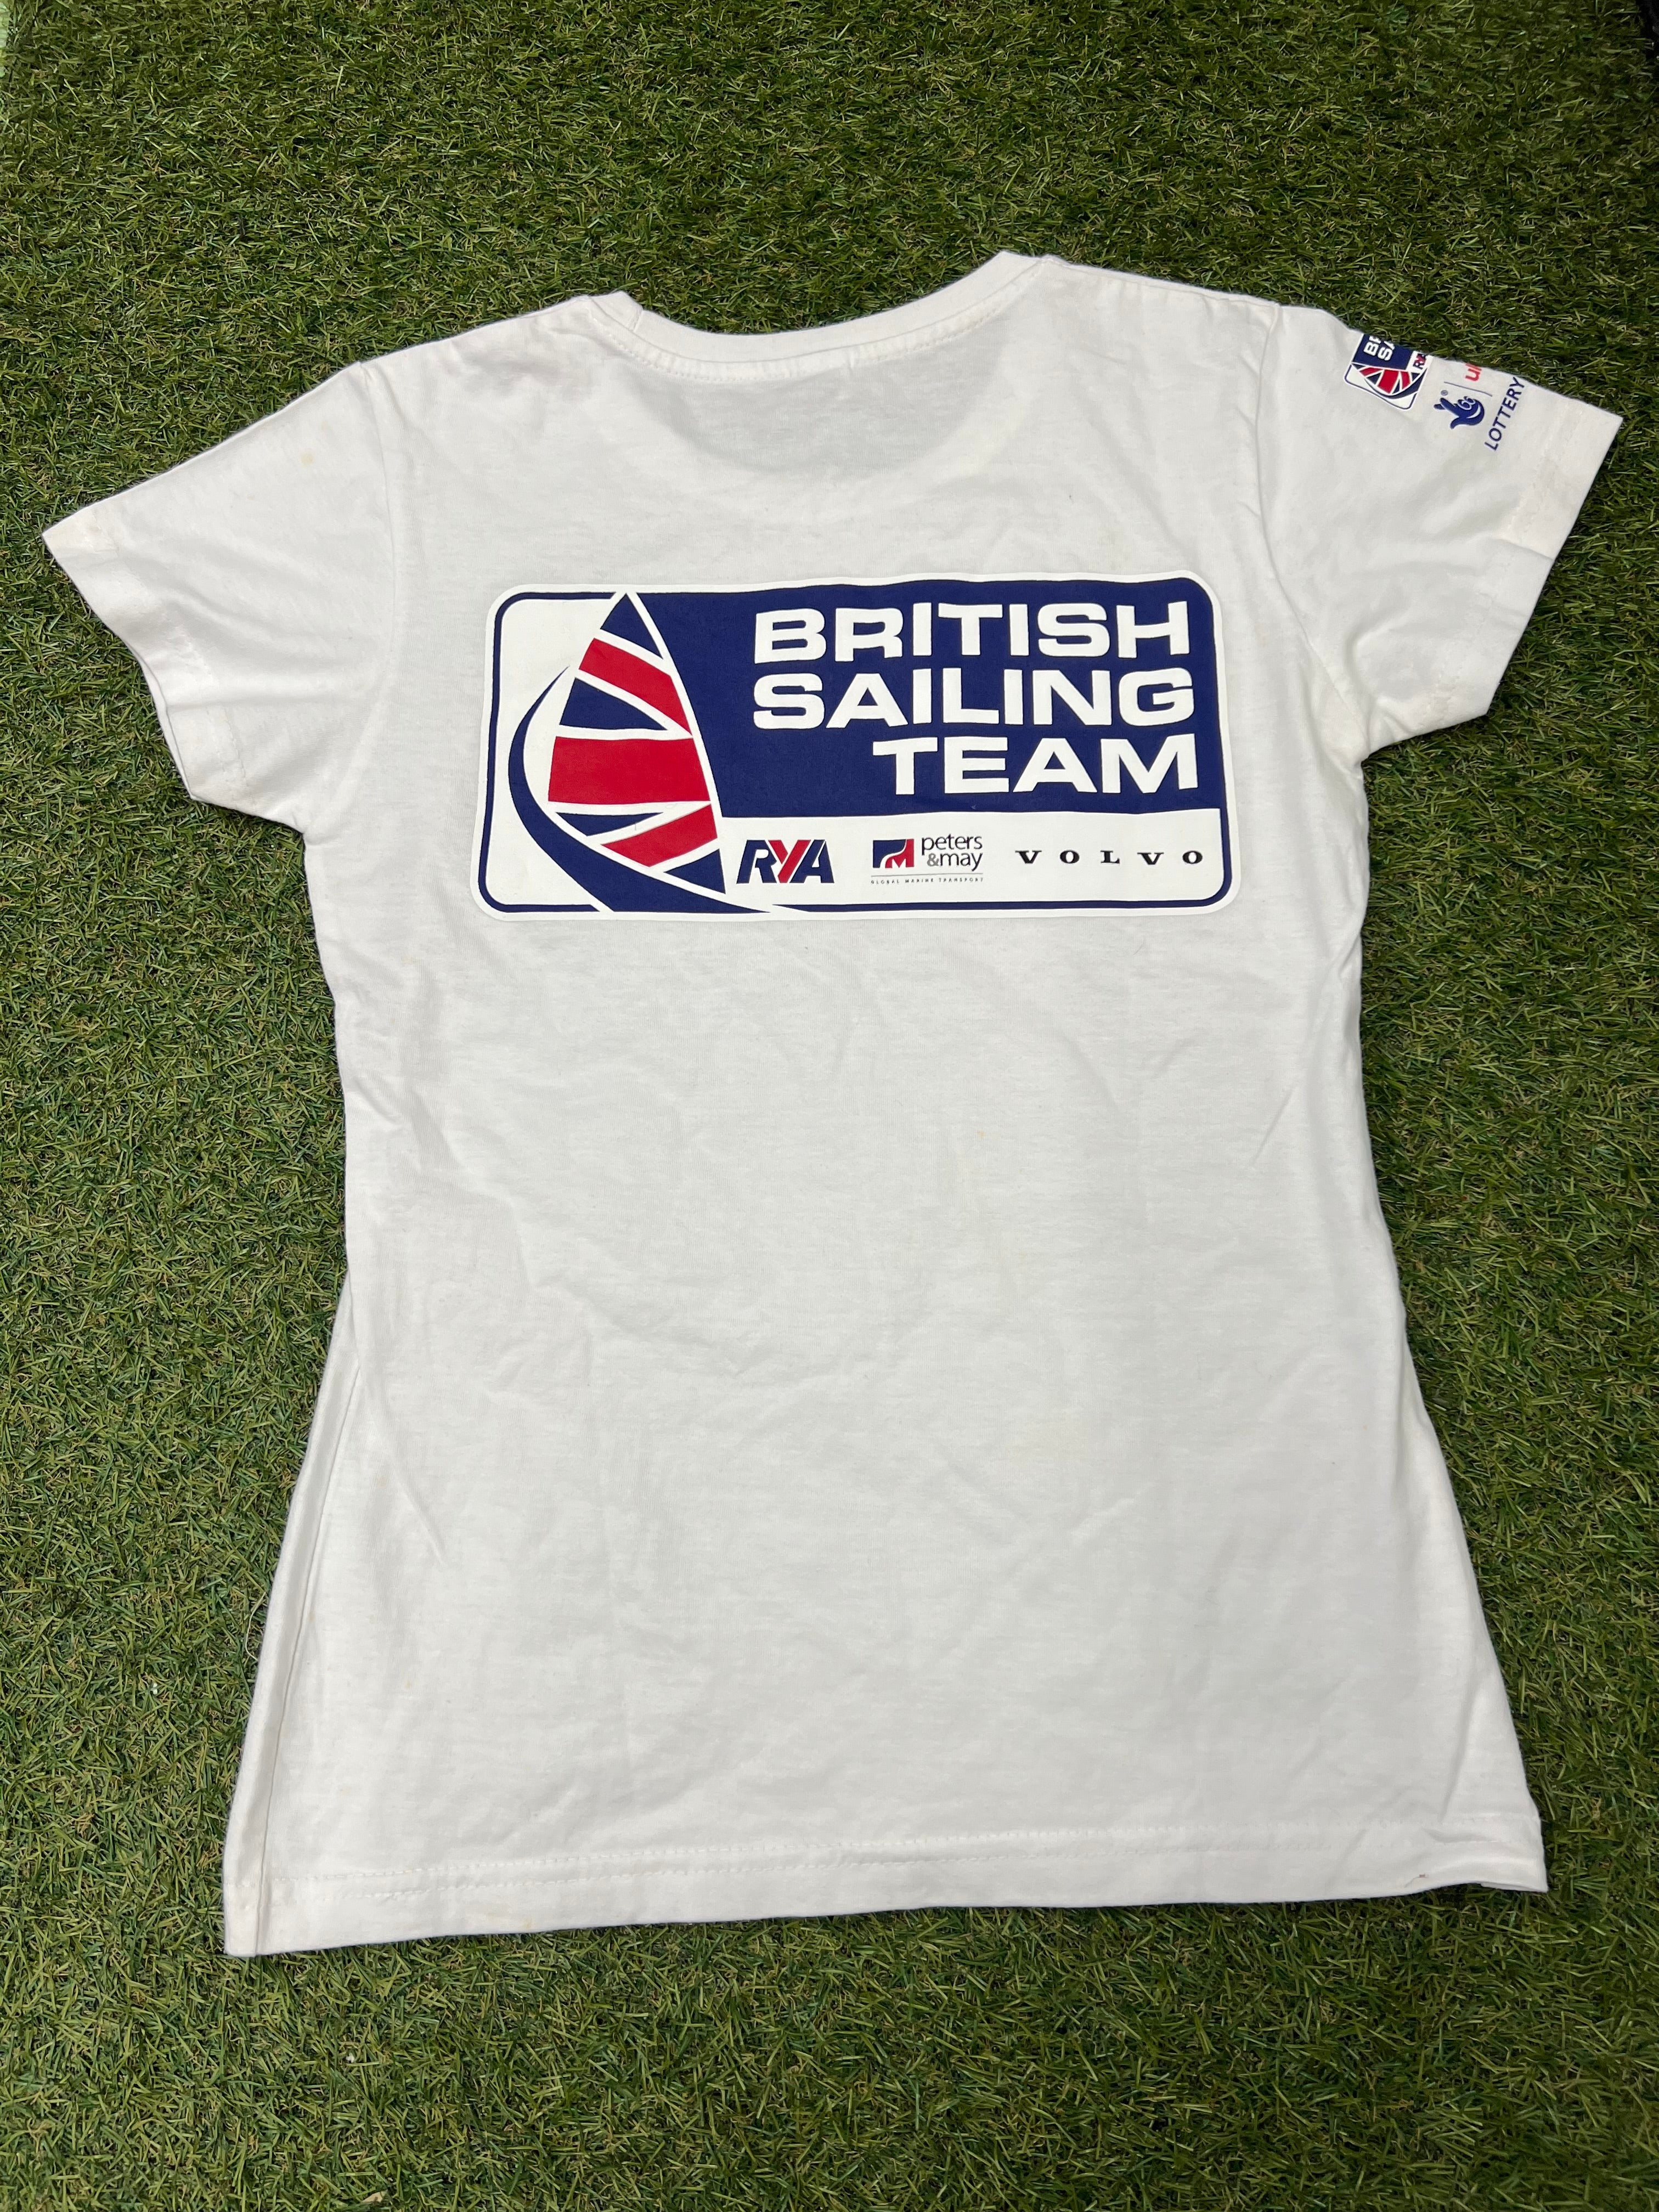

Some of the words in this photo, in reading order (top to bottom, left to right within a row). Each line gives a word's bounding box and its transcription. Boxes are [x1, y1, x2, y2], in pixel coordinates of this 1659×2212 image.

[1485, 376, 1525, 451] LOTTERY
[755, 601, 1189, 664] BRITISH
[754, 668, 1195, 730] SAILING
[873, 733, 1198, 795] TEAM
[736, 839, 834, 884] RYA
[921, 833, 983, 856] peters
[1015, 850, 1203, 865] VOLVO
